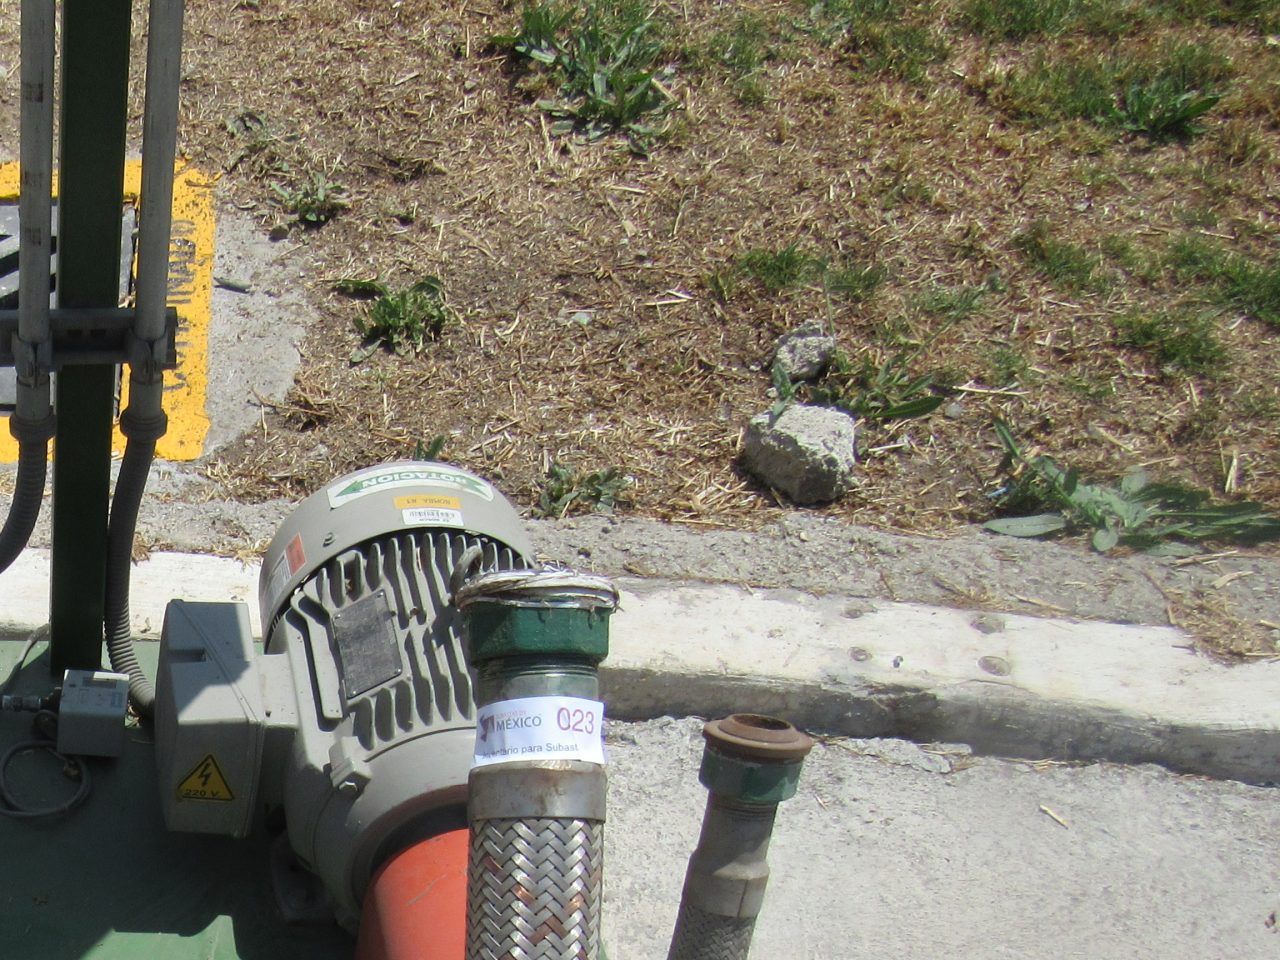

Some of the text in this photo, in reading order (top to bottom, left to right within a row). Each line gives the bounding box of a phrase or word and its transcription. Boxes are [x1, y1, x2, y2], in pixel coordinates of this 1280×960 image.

[361, 471, 469, 489] ROTACION
[496, 715, 542, 732] MÉXICO
[557, 707, 595, 734] 023
[521, 744, 543, 755] para
[183, 789, 207, 797] 220
